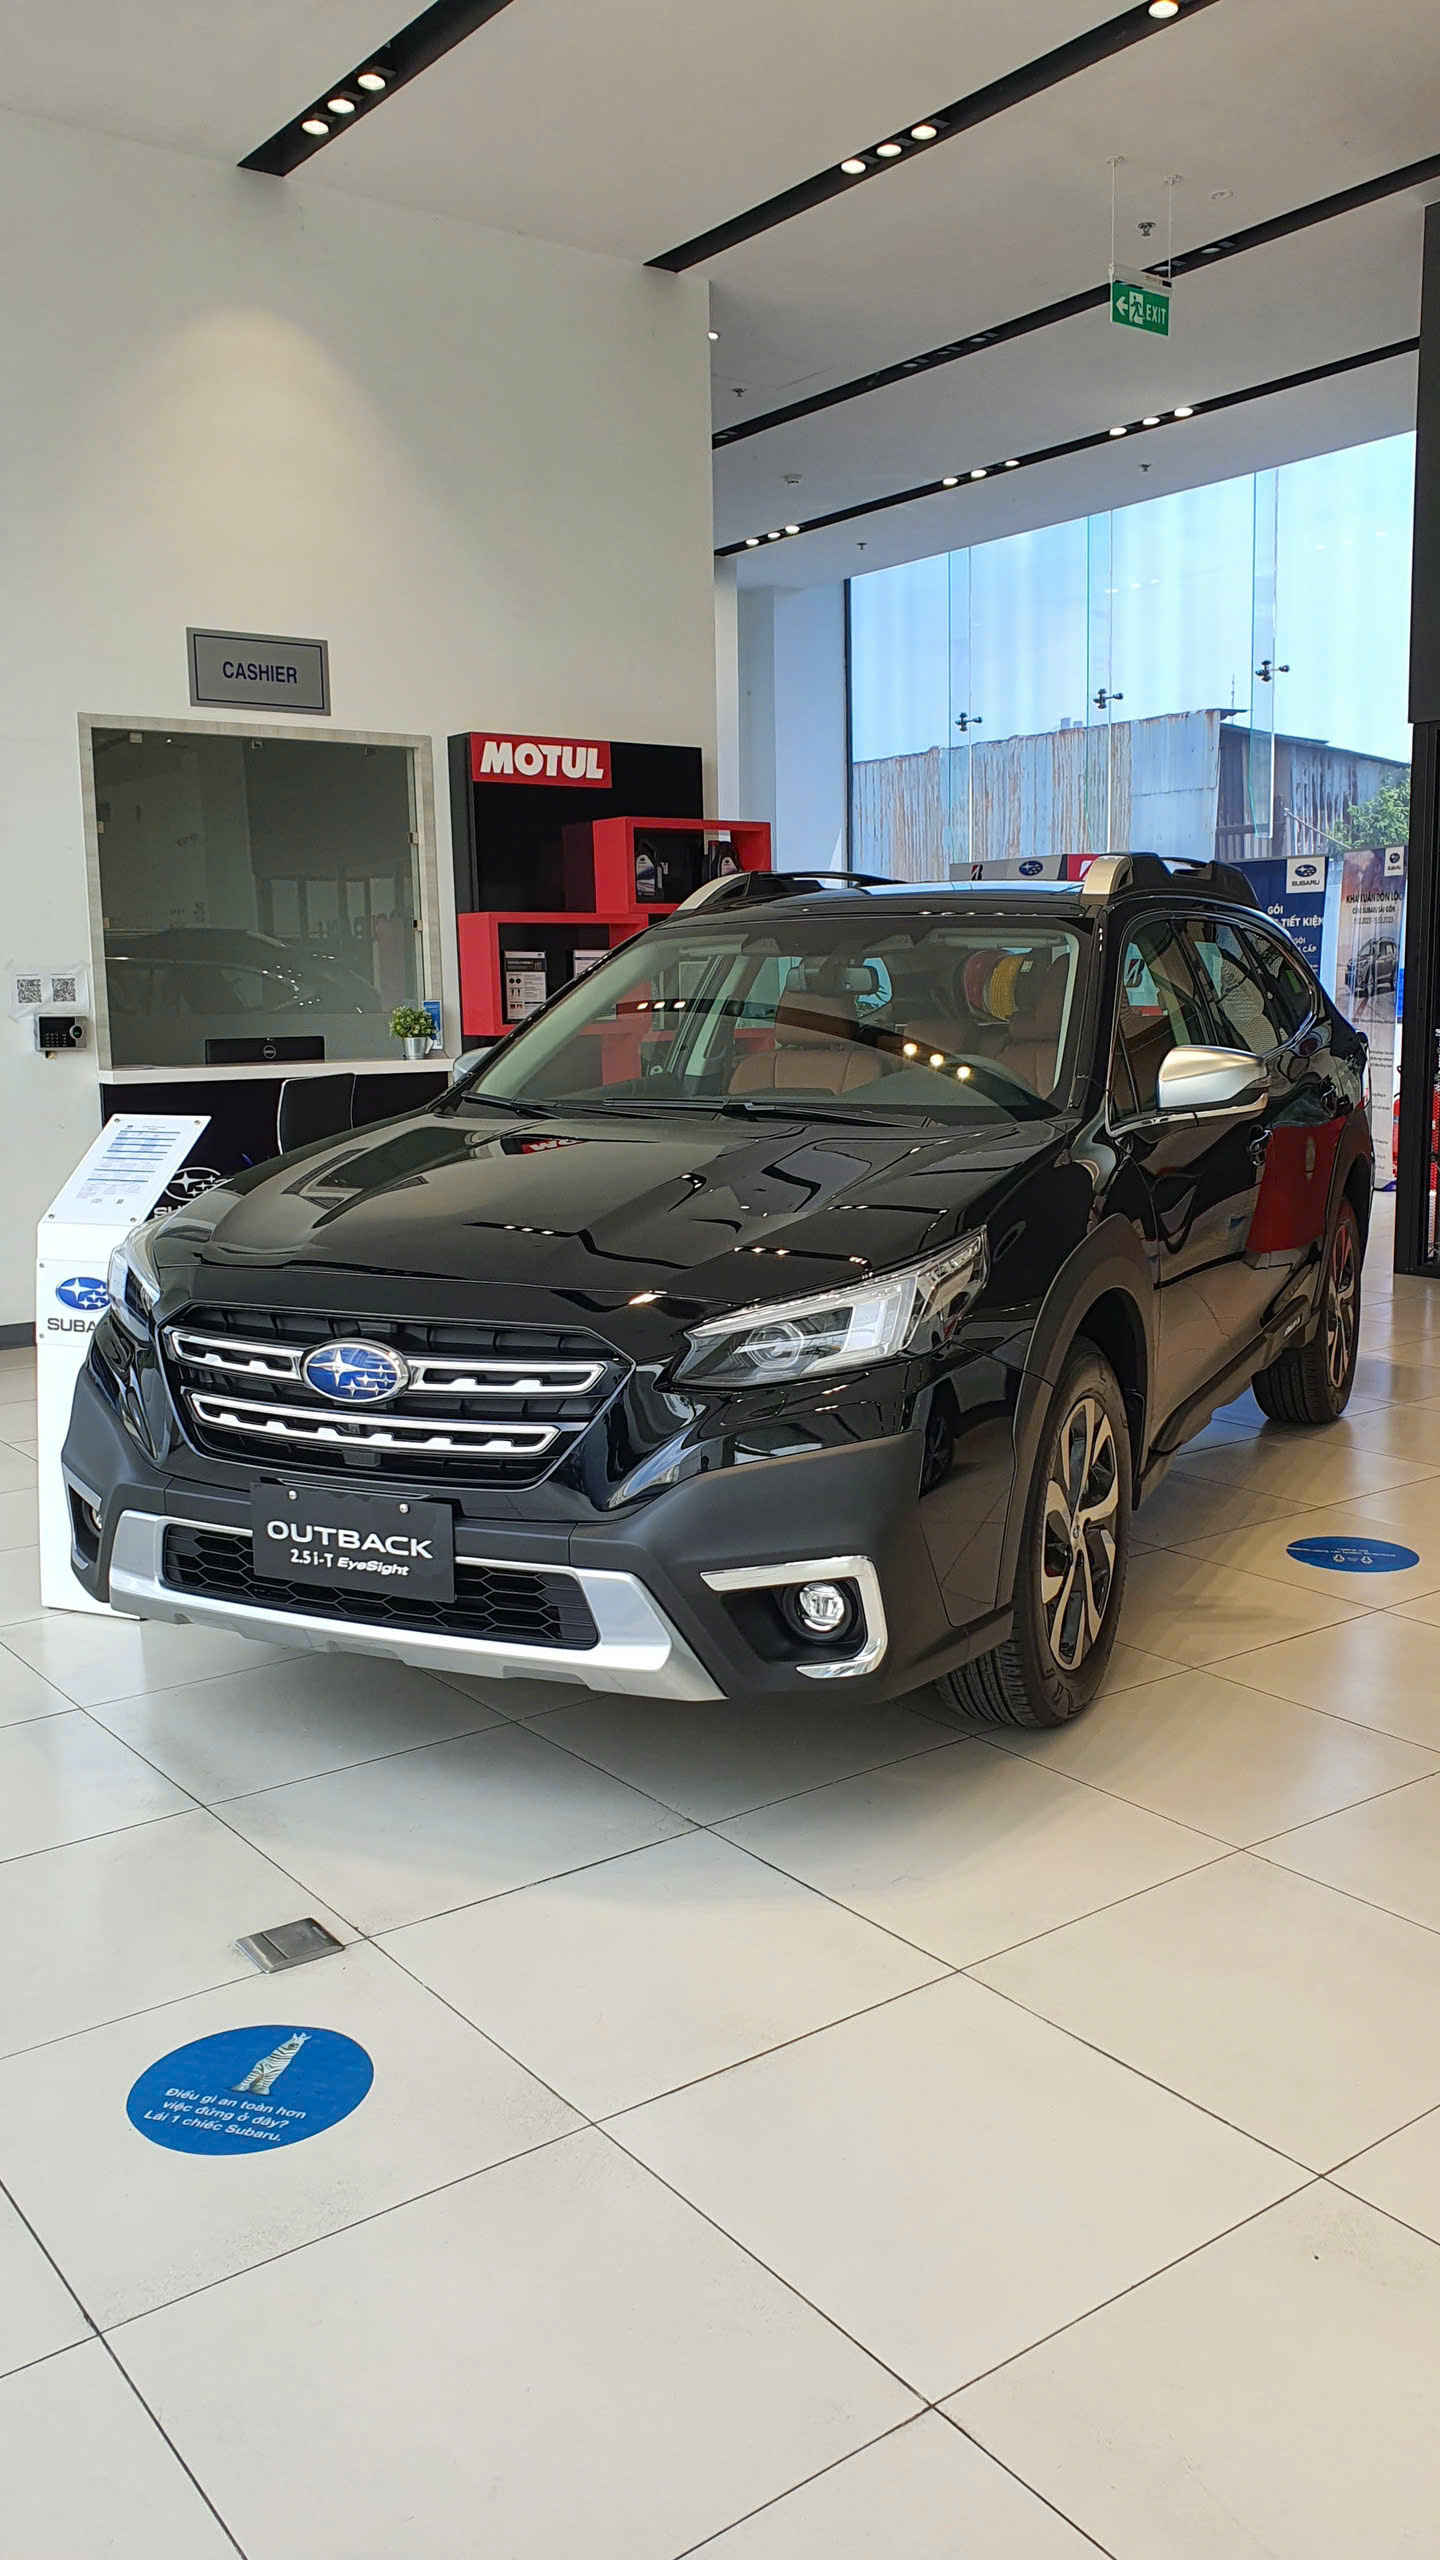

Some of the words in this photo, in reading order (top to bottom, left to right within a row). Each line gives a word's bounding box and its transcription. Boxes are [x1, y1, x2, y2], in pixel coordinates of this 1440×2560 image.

[1146, 304, 1167, 325] EXIT
[222, 661, 298, 684] CASHIER
[480, 741, 605, 779] MOTUL
[1267, 903, 1284, 915] GÓI
[1281, 914, 1301, 927] TIẾT
[47, 1317, 96, 1333] SUBA
[267, 1520, 433, 1559] OUTBACK
[337, 1557, 410, 1576] EyeSight
[163, 2100, 193, 2112] việc
[237, 2112, 250, 2121] ở
[251, 2116, 290, 2128] đây?
[218, 2098, 238, 2107] an
[240, 2101, 274, 2113] toàn
[276, 2106, 306, 2119] hơn
[171, 2115, 181, 2123] 1
[182, 2118, 223, 2131] chiếc
[225, 2124, 281, 2141] Subaru.
